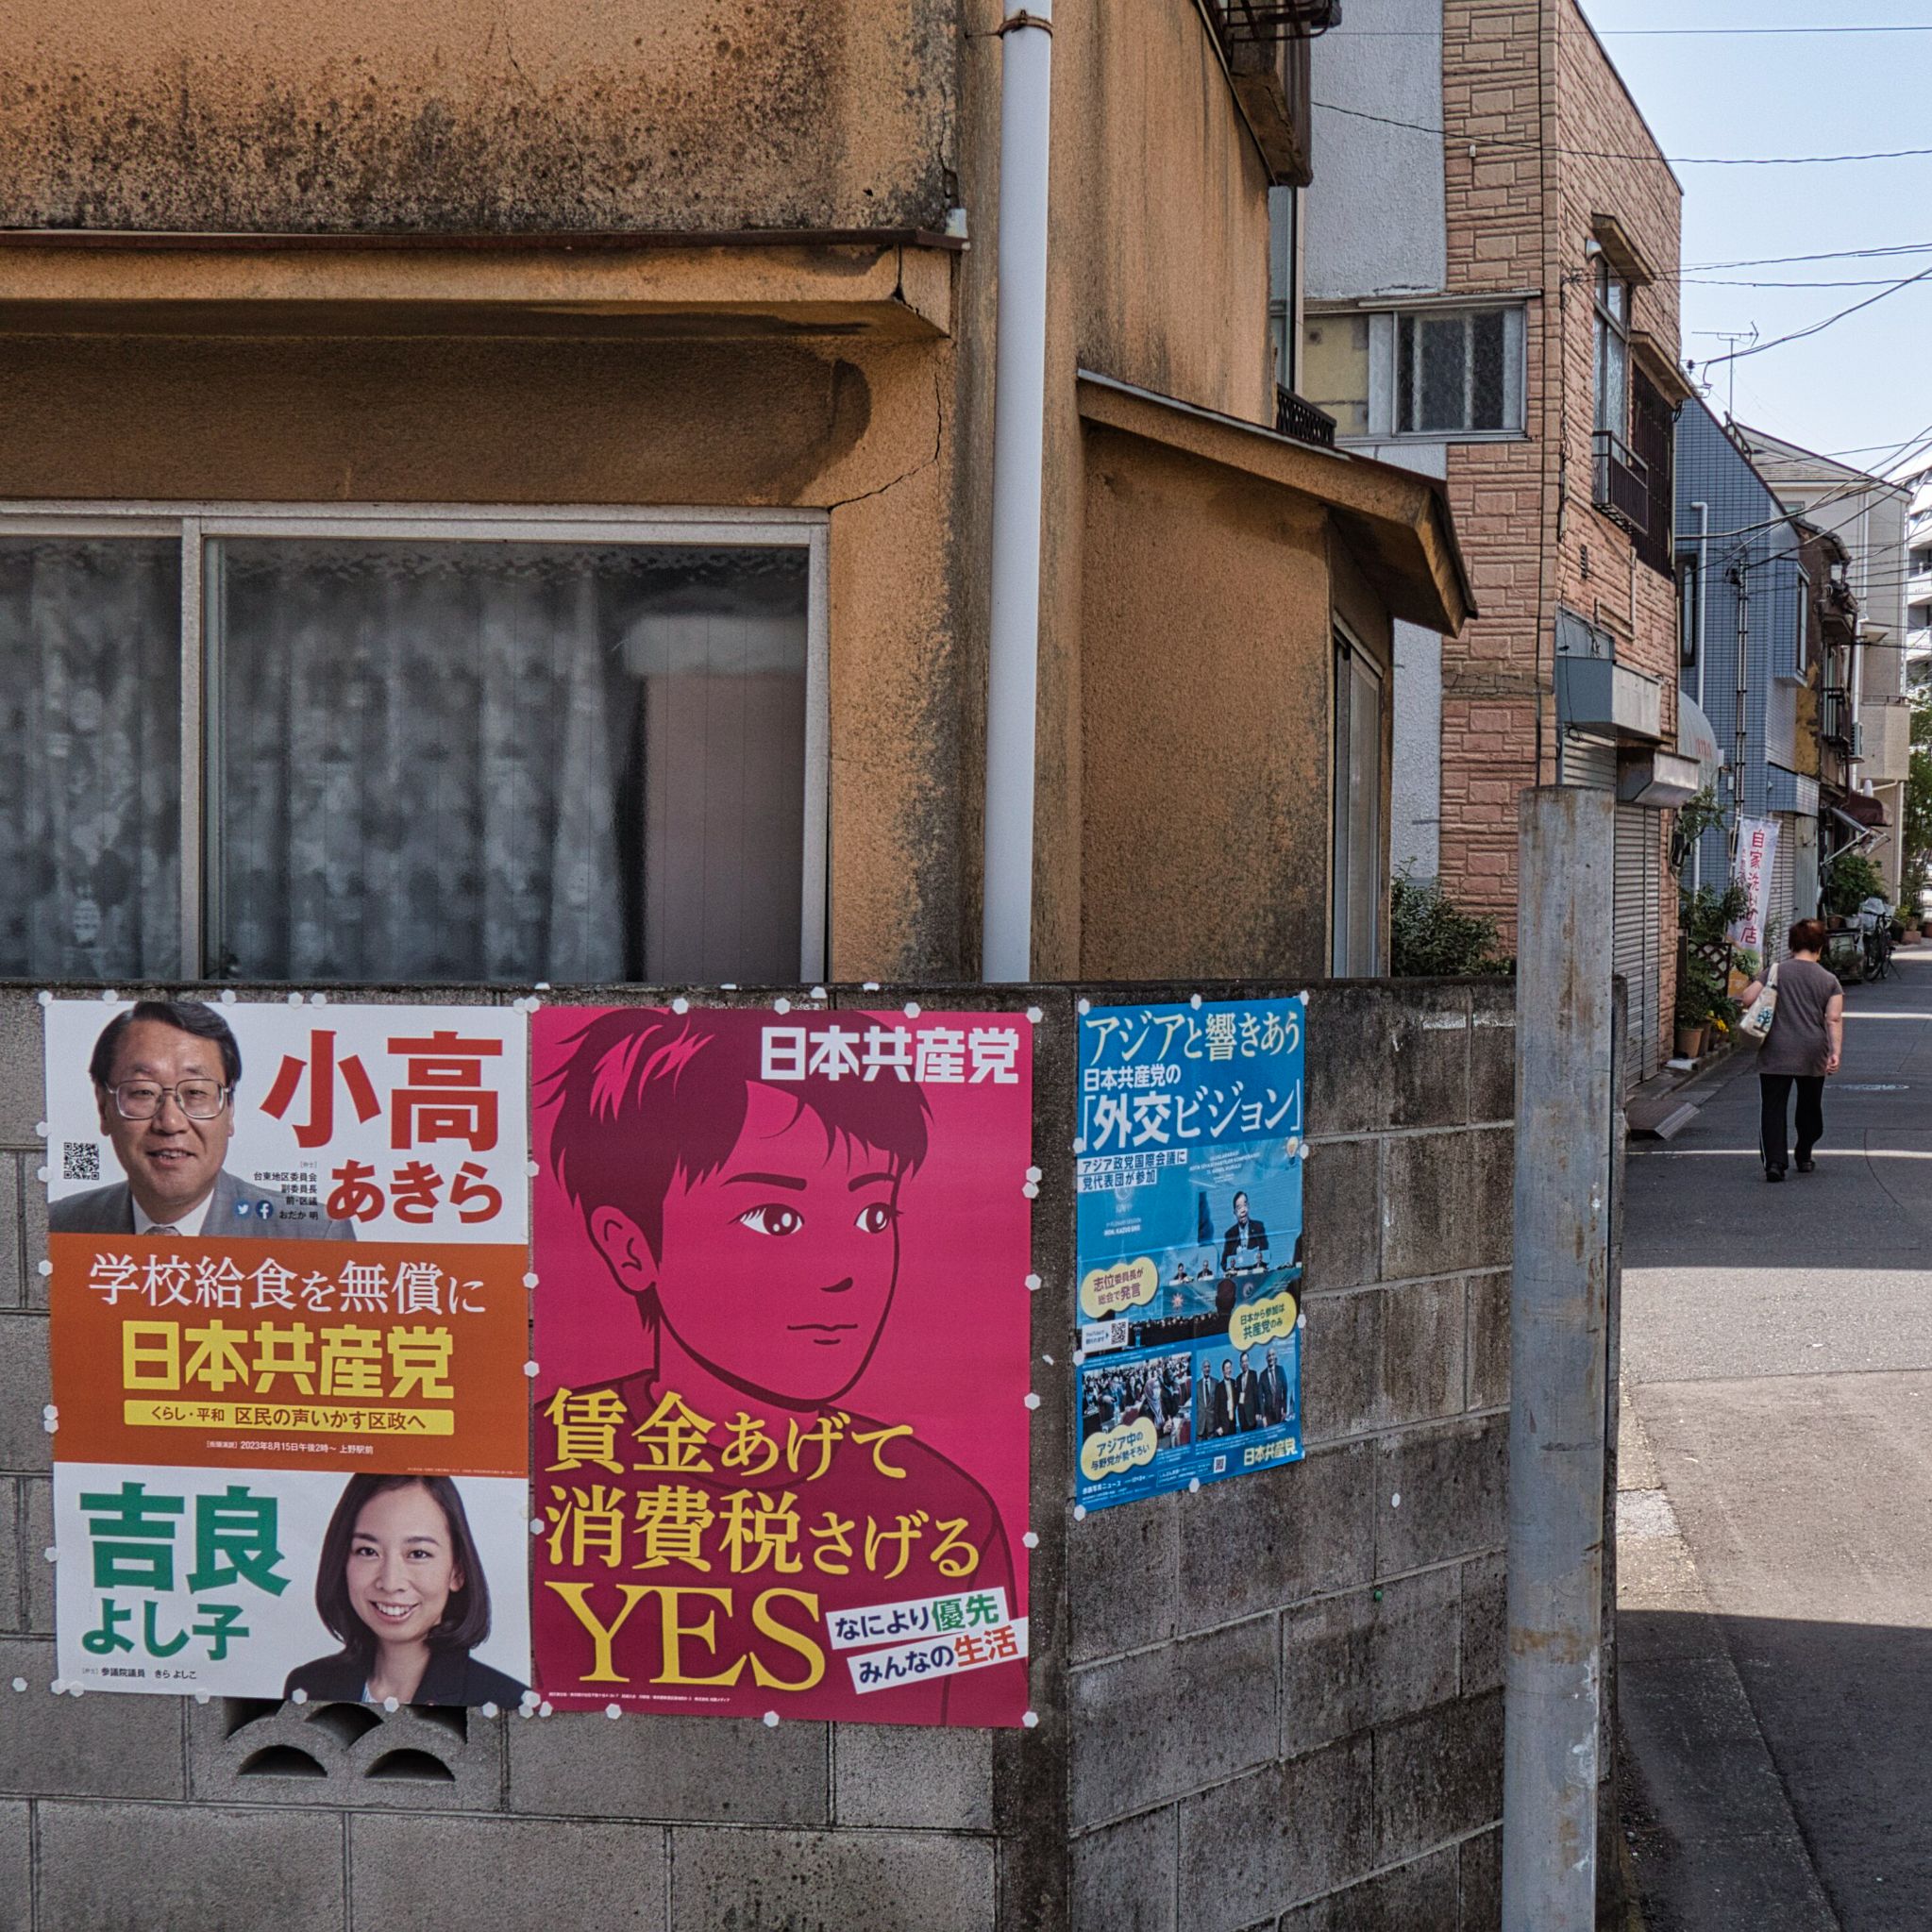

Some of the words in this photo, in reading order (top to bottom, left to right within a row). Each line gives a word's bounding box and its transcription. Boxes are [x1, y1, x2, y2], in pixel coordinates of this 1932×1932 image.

[761, 1025, 1019, 1084] 日本共産党
[1085, 1010, 1300, 1066] アジアと響きあう
[260, 1030, 503, 1151] 小高
[1084, 1064, 1182, 1091] 日本共産党の
[253, 1171, 318, 1183] 台東地区委員会
[1083, 1151, 1186, 1172] アジア政党国際会議に
[1083, 1170, 1156, 1190] 党代表団が参加
[327, 1159, 503, 1225] あきら
[88, 1252, 487, 1316] 学校給食を無償に
[1093, 1267, 1144, 1292] 志位委員長が
[1243, 1317, 1284, 1340] 共産党のみ
[123, 1319, 455, 1399] 日本共産党
[151, 1406, 226, 1423] くらし・平和
[235, 1407, 427, 1431] 区民の声いかす区政へ
[544, 1386, 915, 1481] 賃金あげて
[1097, 1431, 1144, 1456] アジア中の
[1244, 1437, 1298, 1466] 日本共産党
[79, 1482, 292, 1596] 吉良
[545, 1485, 980, 1580] 消費税さげる
[81, 1598, 249, 1661] よし子
[544, 1581, 827, 1692] YES
[834, 1594, 1000, 1640] なにより優先
[101, 1667, 145, 1678] 参議院議員
[154, 1670, 170, 1678] きら
[173, 1671, 197, 1680] よしこ
[859, 1624, 1019, 1684] みんなの生活
